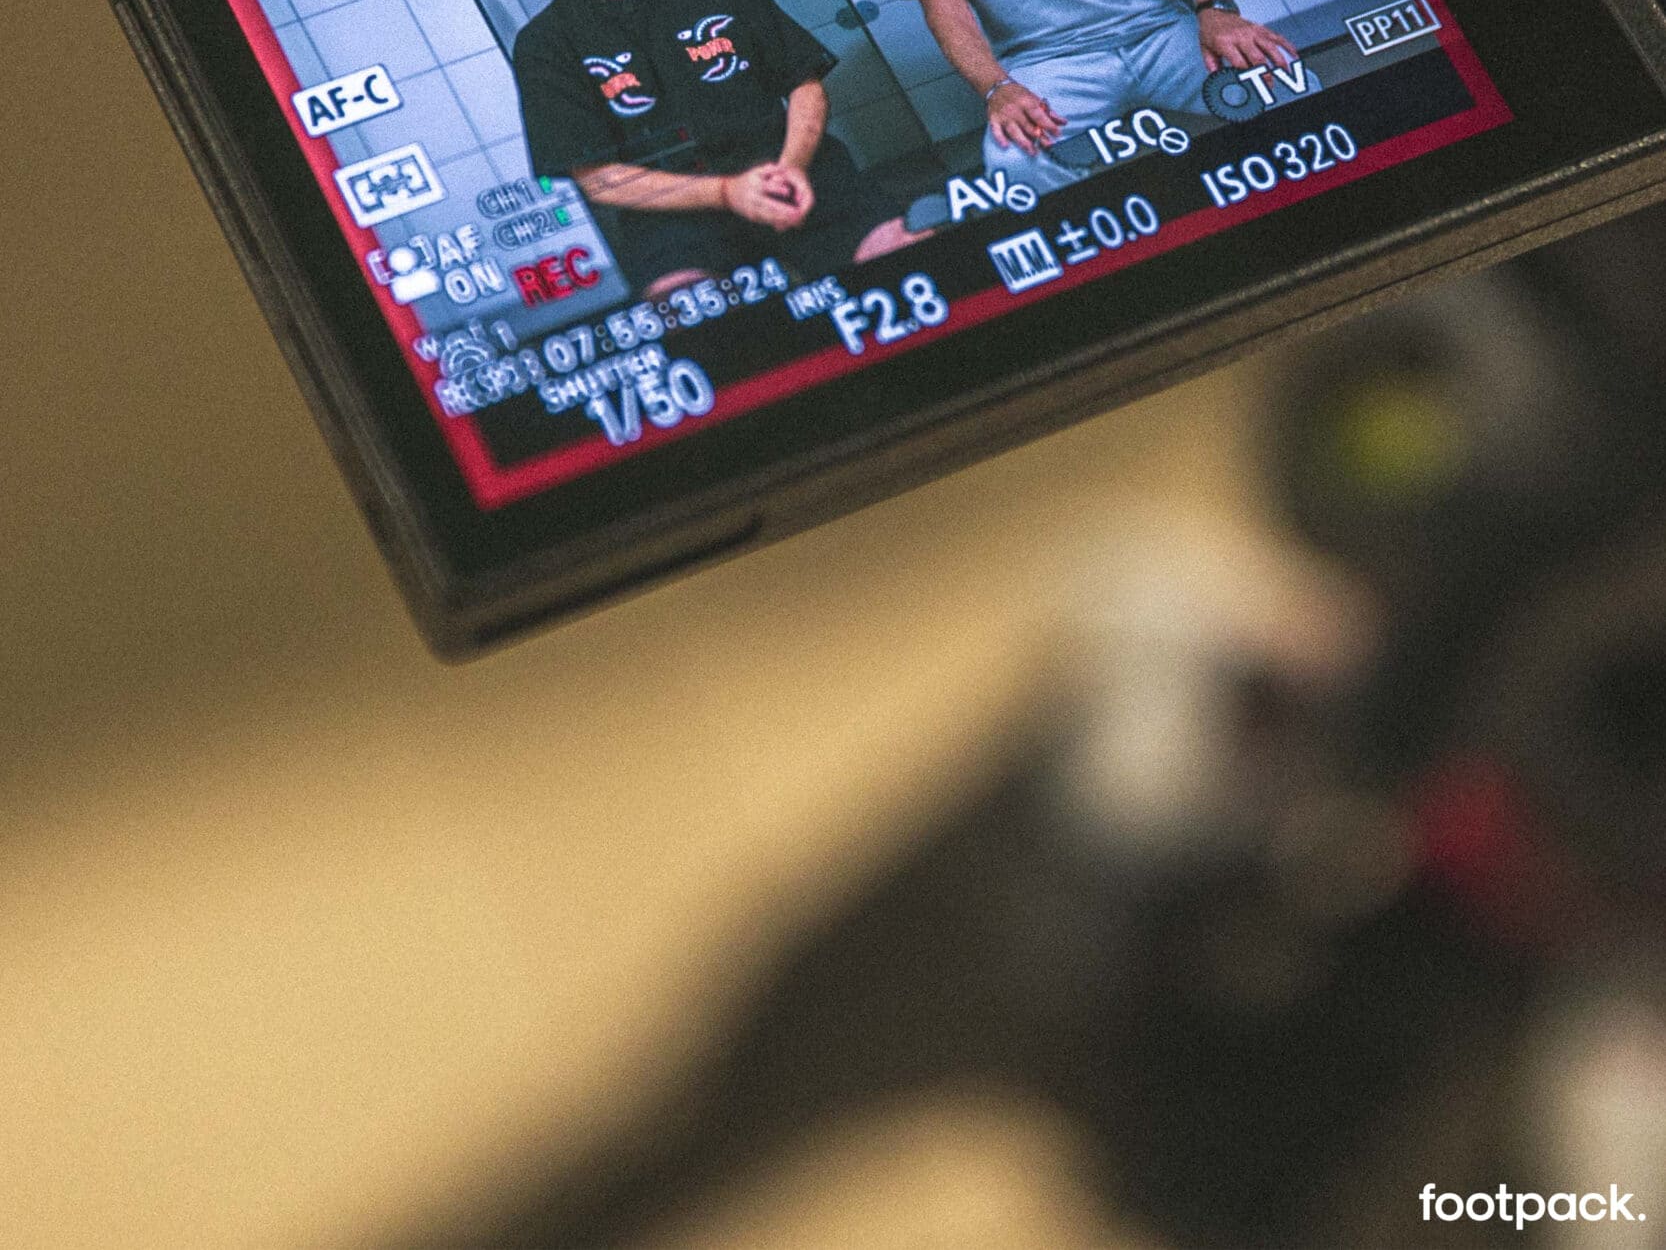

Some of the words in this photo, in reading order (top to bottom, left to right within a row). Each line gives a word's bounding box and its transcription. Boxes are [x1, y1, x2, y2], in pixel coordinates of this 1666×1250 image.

[1355, 3, 1426, 47] PP11
[306, 73, 389, 127] AF-C
[1088, 109, 1168, 165] ISO
[1202, 154, 1279, 209] ISO
[1272, 123, 1358, 180] 320
[437, 224, 483, 271] AF
[443, 257, 506, 305] ON
[511, 247, 600, 308] REC
[830, 272, 950, 355] F2.8
